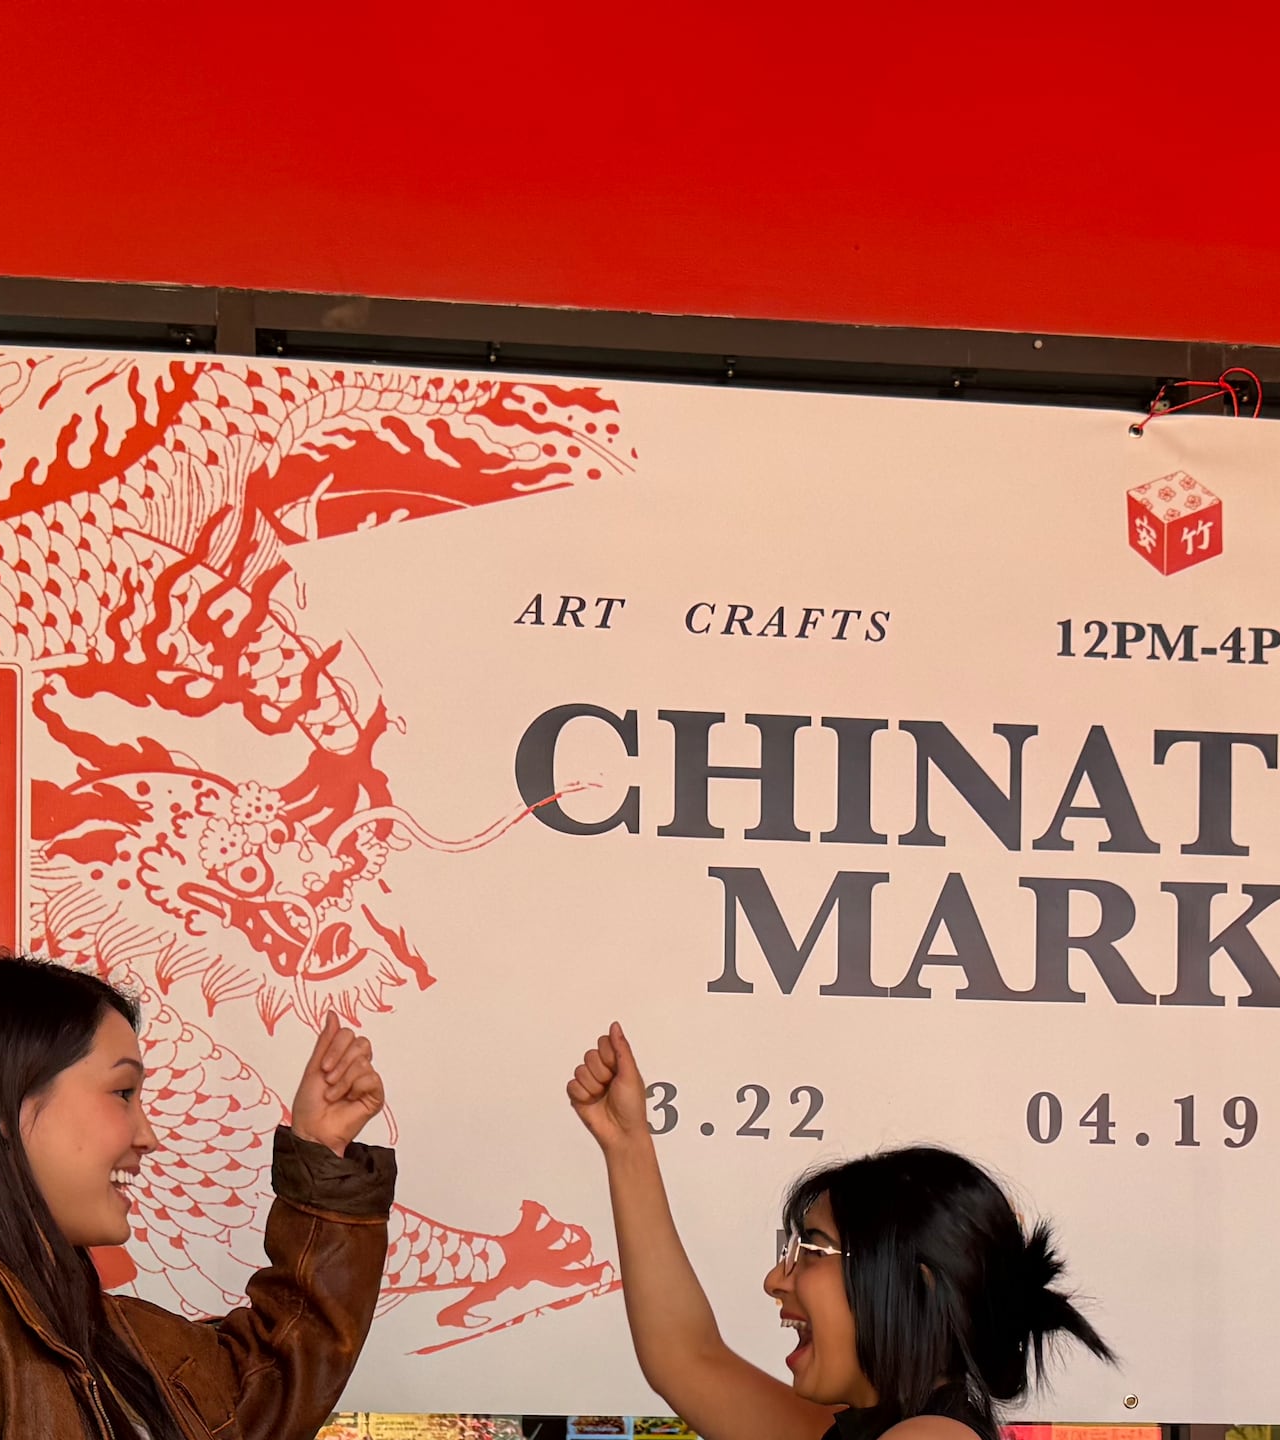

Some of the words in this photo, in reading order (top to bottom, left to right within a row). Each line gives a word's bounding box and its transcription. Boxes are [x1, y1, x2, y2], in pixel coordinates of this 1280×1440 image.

[1181, 520, 1213, 555] 竹
[514, 593, 626, 629] ART
[685, 602, 890, 642] CRAFTS
[1026, 1091, 1258, 1148] 04.19
